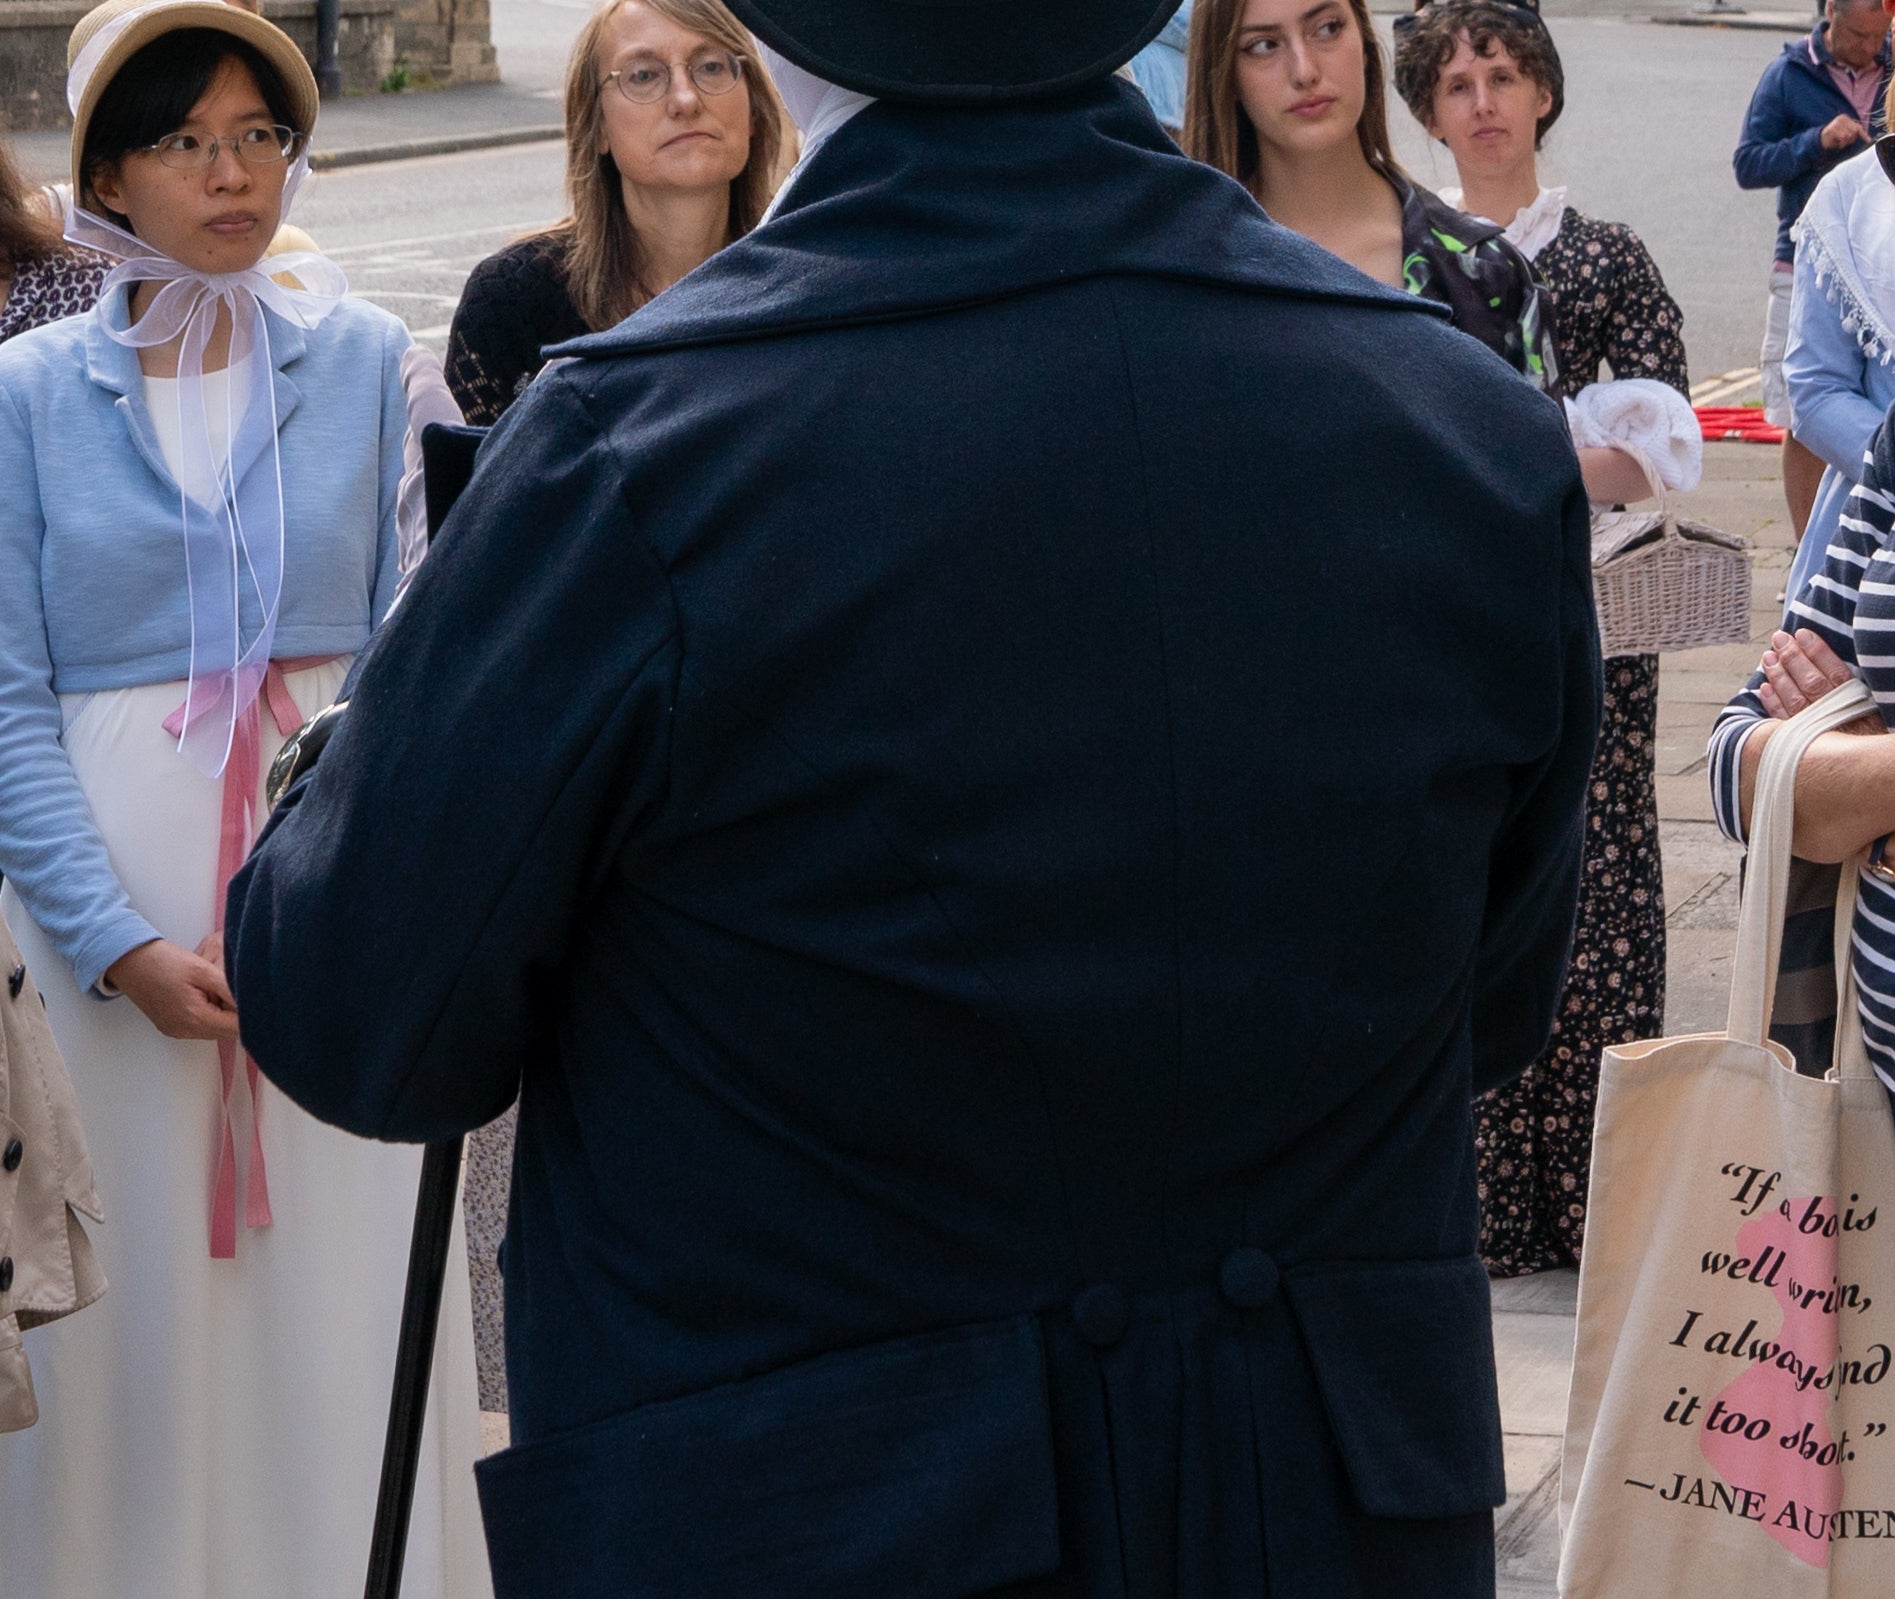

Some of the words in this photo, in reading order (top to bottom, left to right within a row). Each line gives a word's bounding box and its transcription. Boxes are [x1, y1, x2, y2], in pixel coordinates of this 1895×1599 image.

[1779, 1199, 1792, 1222] a
[1843, 1193, 1878, 1231] is
[1701, 1246, 1786, 1287] well
[1669, 1310, 1704, 1347] I
[1704, 1319, 1833, 1392] always
[1663, 1386, 1701, 1426] it
[1706, 1400, 1771, 1441] too
